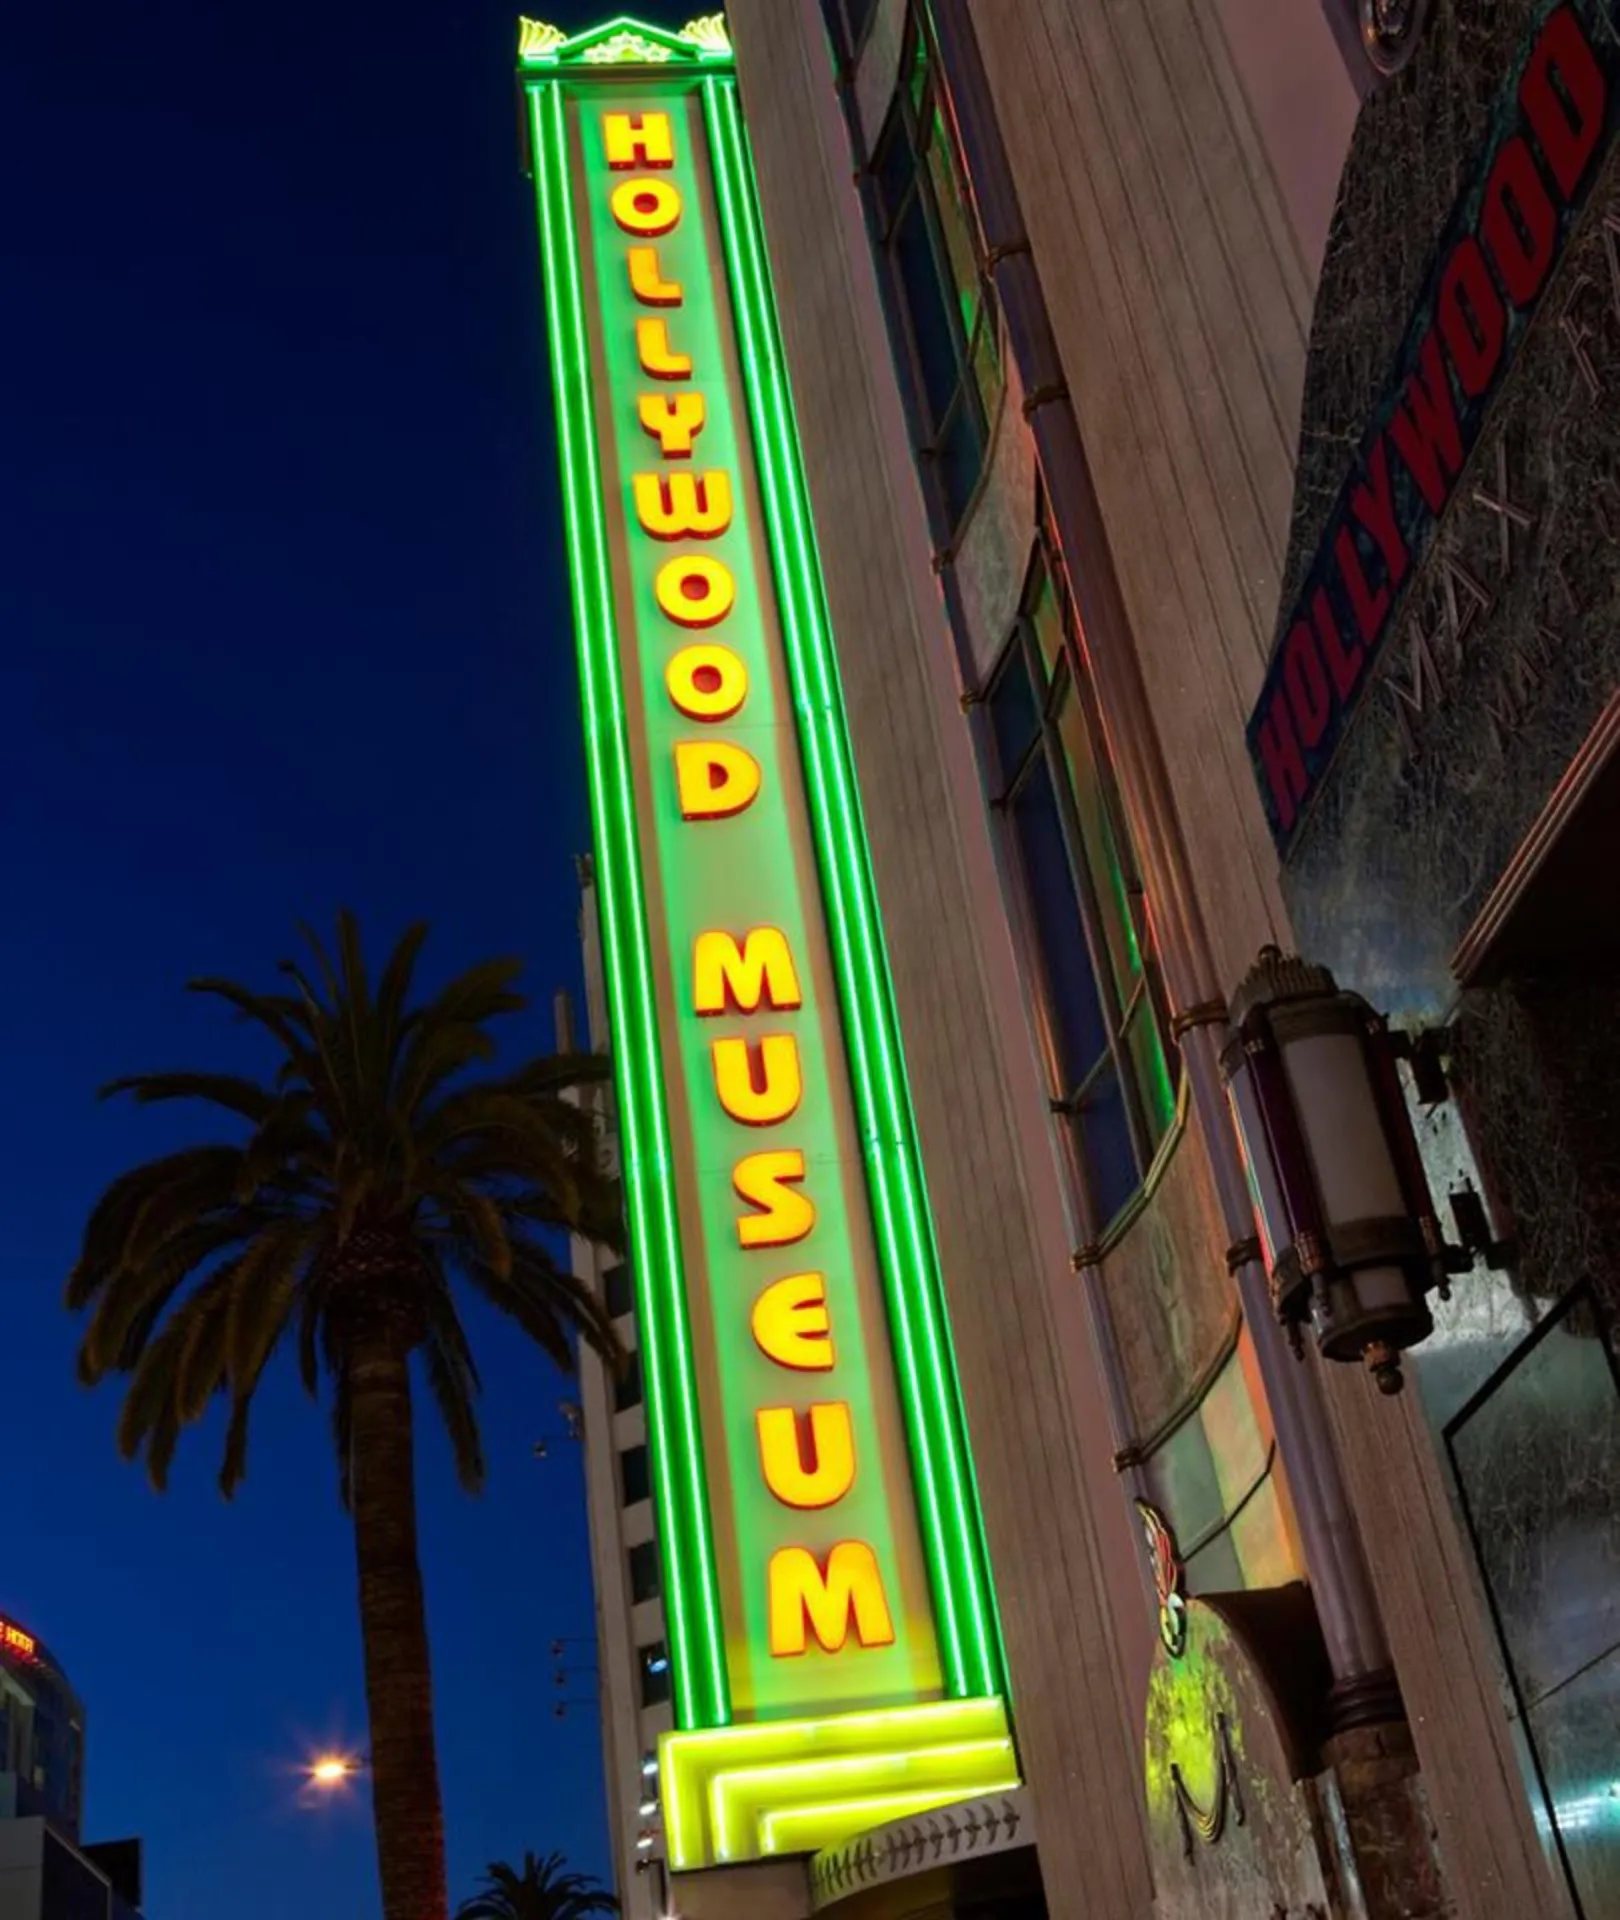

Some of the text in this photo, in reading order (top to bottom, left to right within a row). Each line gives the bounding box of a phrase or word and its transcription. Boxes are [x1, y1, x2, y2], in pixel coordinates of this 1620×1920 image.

[603, 111, 895, 1657] HOLLYWOOD MUSEUM
[1258, 5, 1605, 831] HOLLYWOOD
